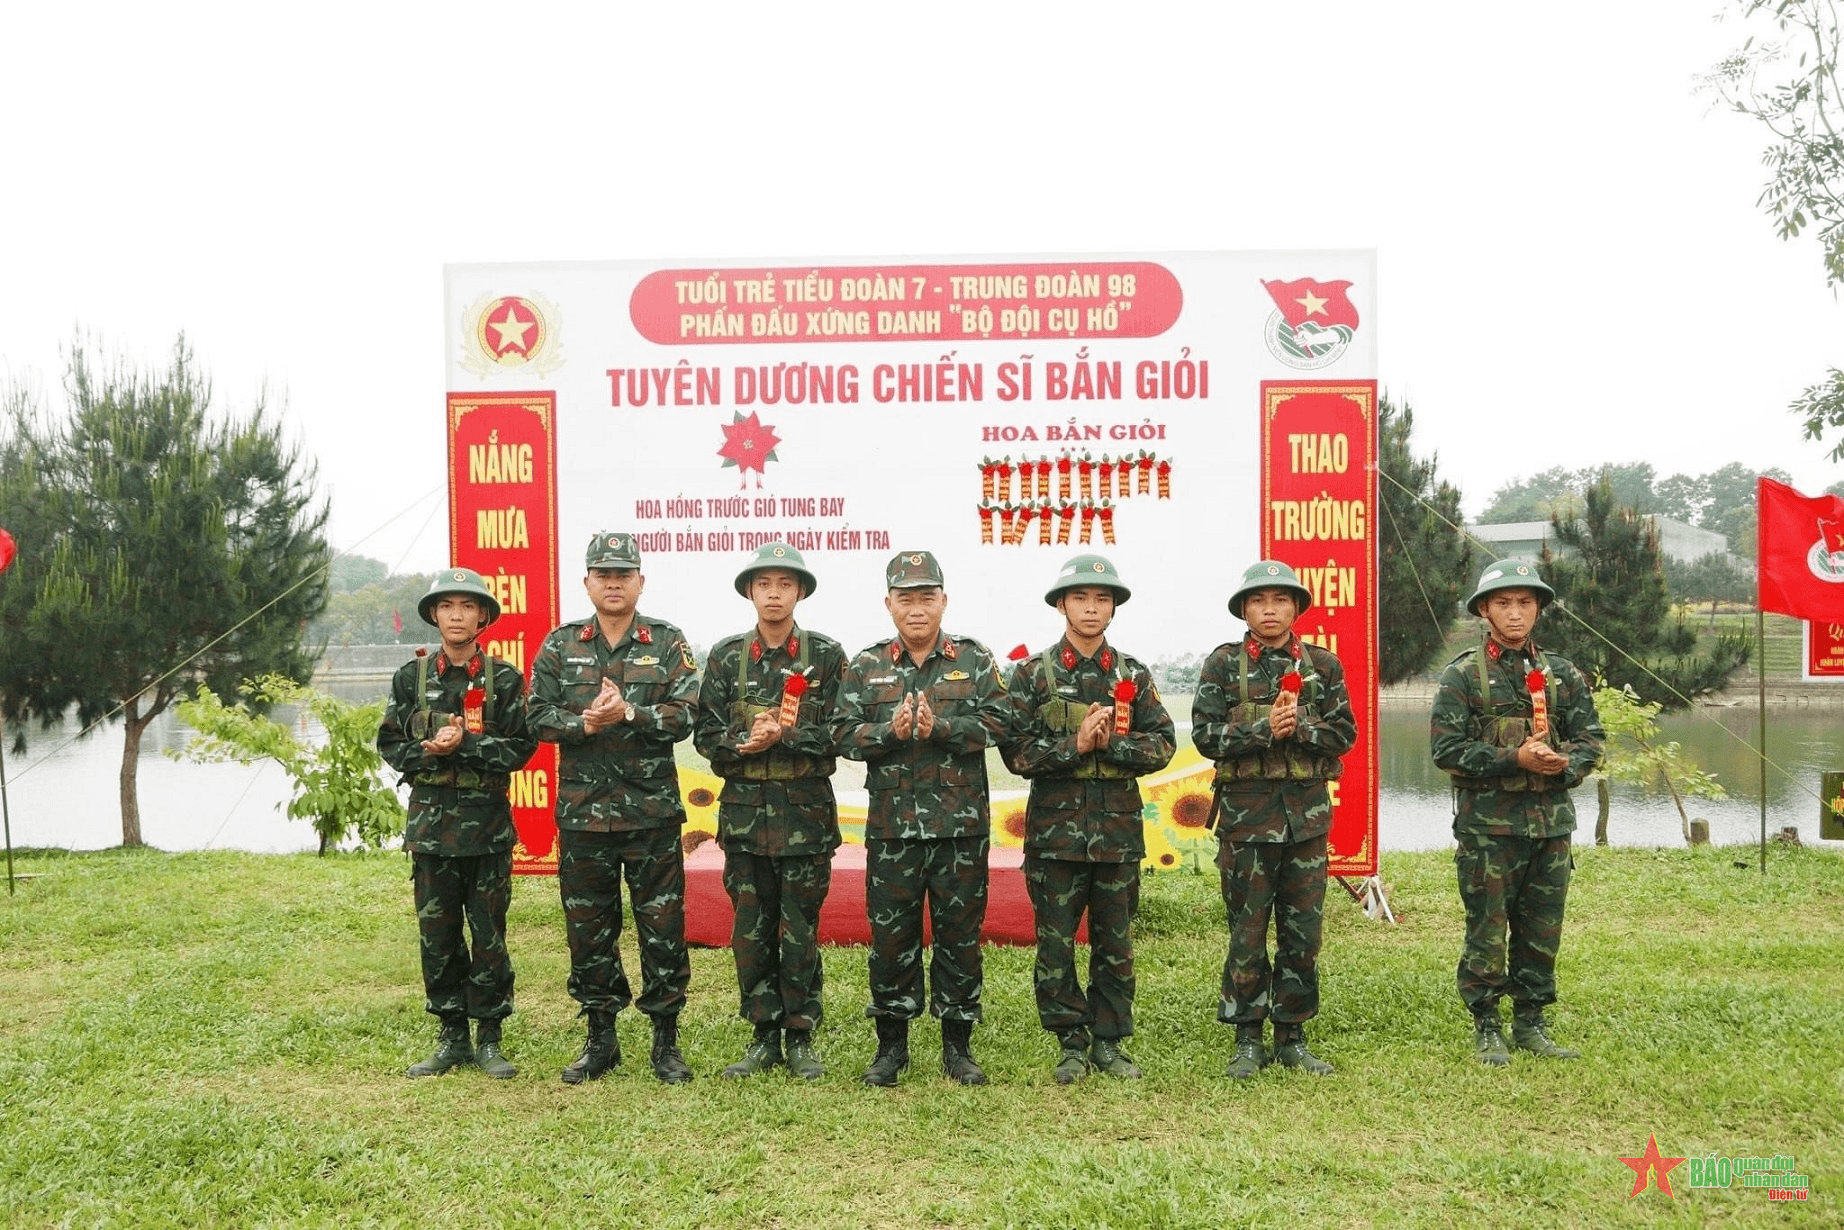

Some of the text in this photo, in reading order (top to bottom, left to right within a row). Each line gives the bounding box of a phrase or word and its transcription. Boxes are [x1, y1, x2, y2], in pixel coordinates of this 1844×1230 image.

[675, 269, 1137, 304] TUỔI TRẺ TIỂU ĐOÀN 7 - TRUNG ĐOÀN 98
[680, 305, 744, 338] PHẤN
[751, 304, 799, 337] ĐẤU
[805, 306, 870, 335] XỨNG
[877, 309, 941, 335] DANH
[1000, 304, 1041, 337] ĐỘI
[1048, 307, 1080, 337] CỤ
[606, 346, 1209, 407] TUYÊN DƯƠNG CHIẾN SĨ BẮN GIỎI
[982, 416, 1167, 442] HOA BẮN GIỎI
[469, 428, 534, 484] NẮNG
[1288, 433, 1349, 474] THAO
[636, 493, 845, 519] HOA HỒNG TRƯỚC GIÓ TUNG BAY
[1271, 490, 1366, 541] TRƯỜNG
[477, 505, 529, 549] MƯA
[676, 525, 704, 552] BẮN
[708, 525, 735, 552] GIỎI
[786, 527, 823, 551] NGÀY
[827, 523, 861, 551] KIỂM
[865, 530, 891, 550] TRA
